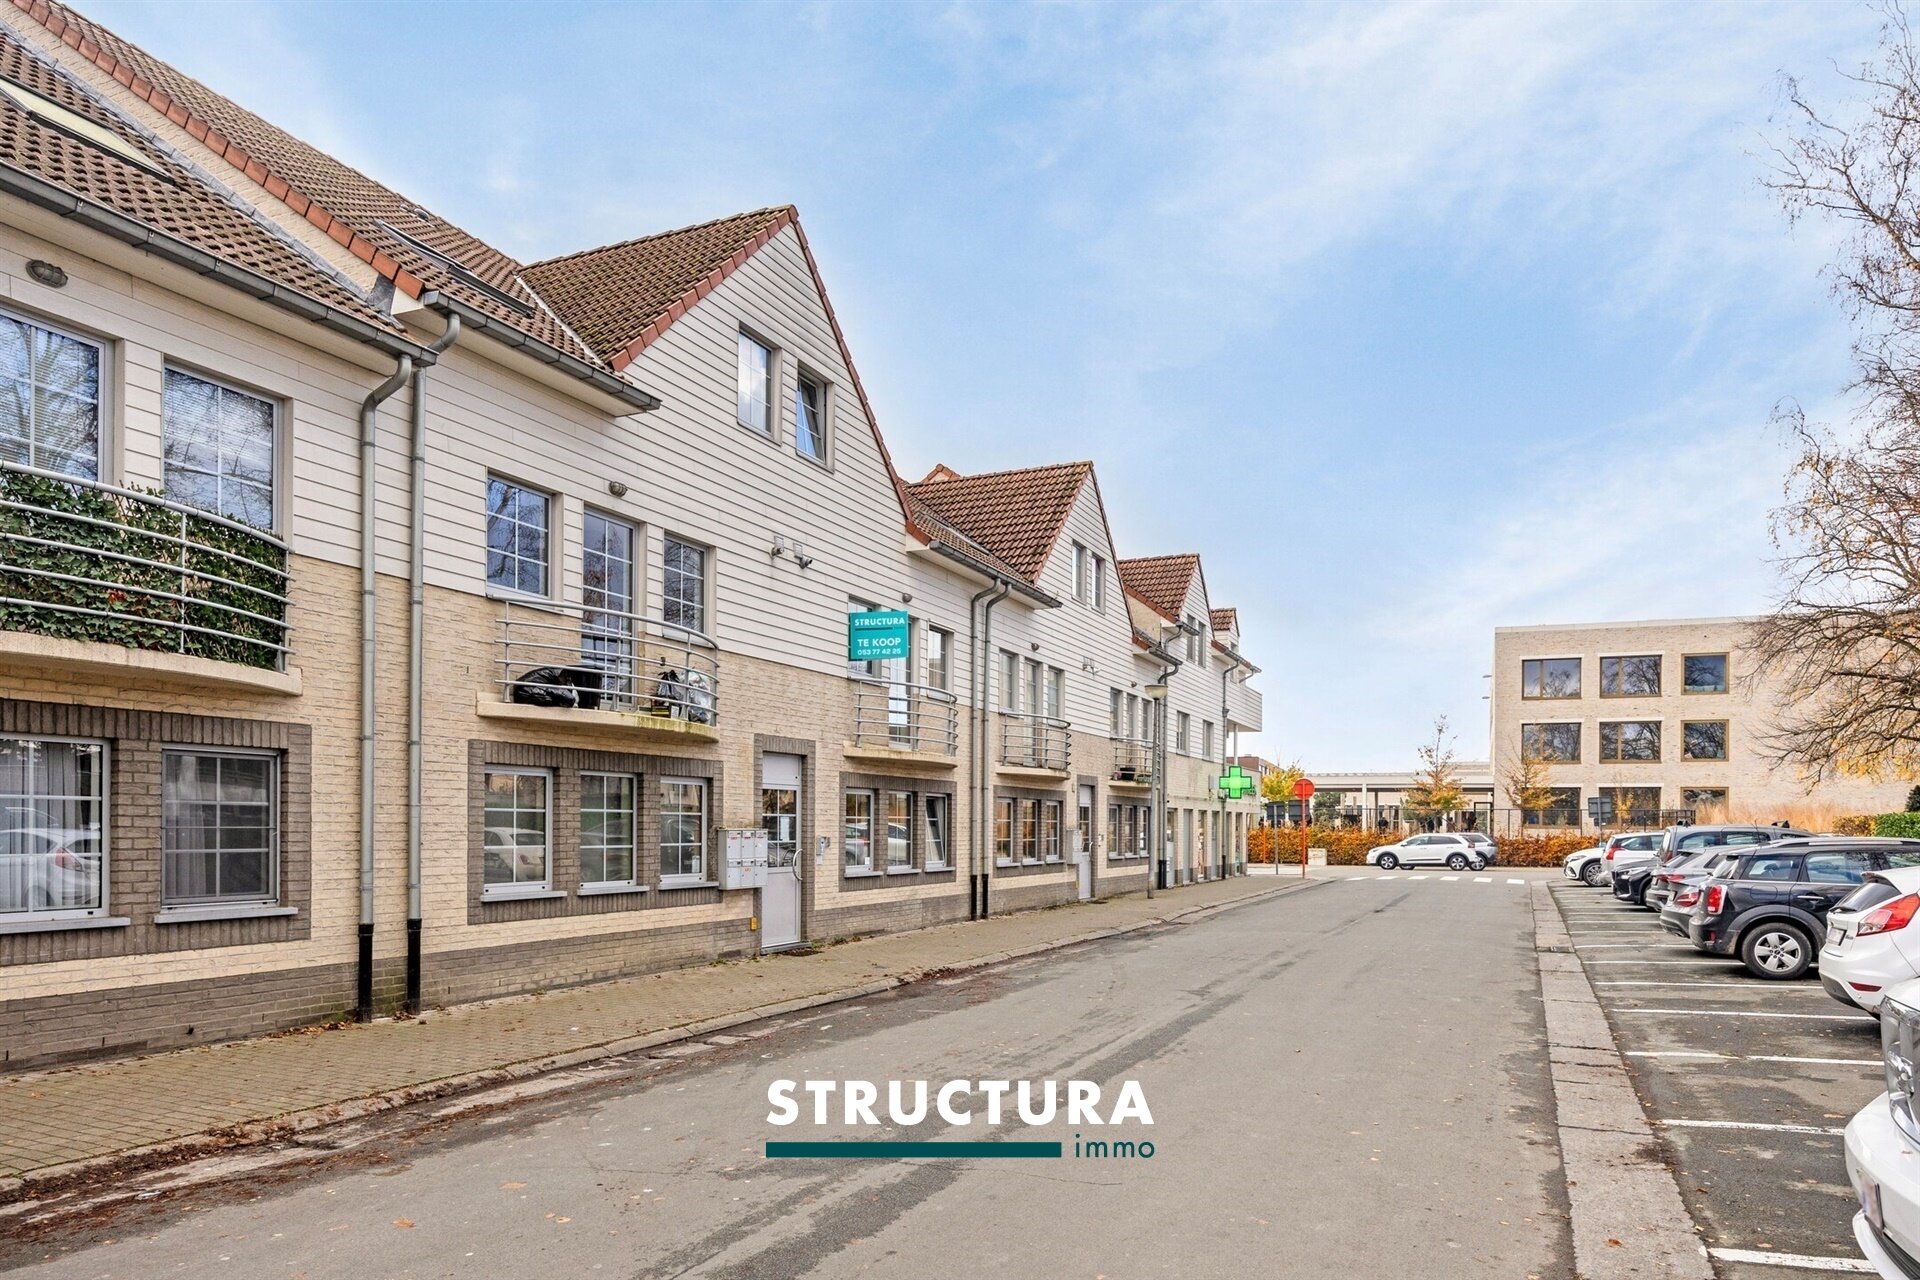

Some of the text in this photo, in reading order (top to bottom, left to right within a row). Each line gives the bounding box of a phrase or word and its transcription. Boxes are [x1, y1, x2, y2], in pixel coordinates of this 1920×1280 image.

[854, 617, 905, 626] STRUCTURA
[857, 637, 901, 647] TE KOOP
